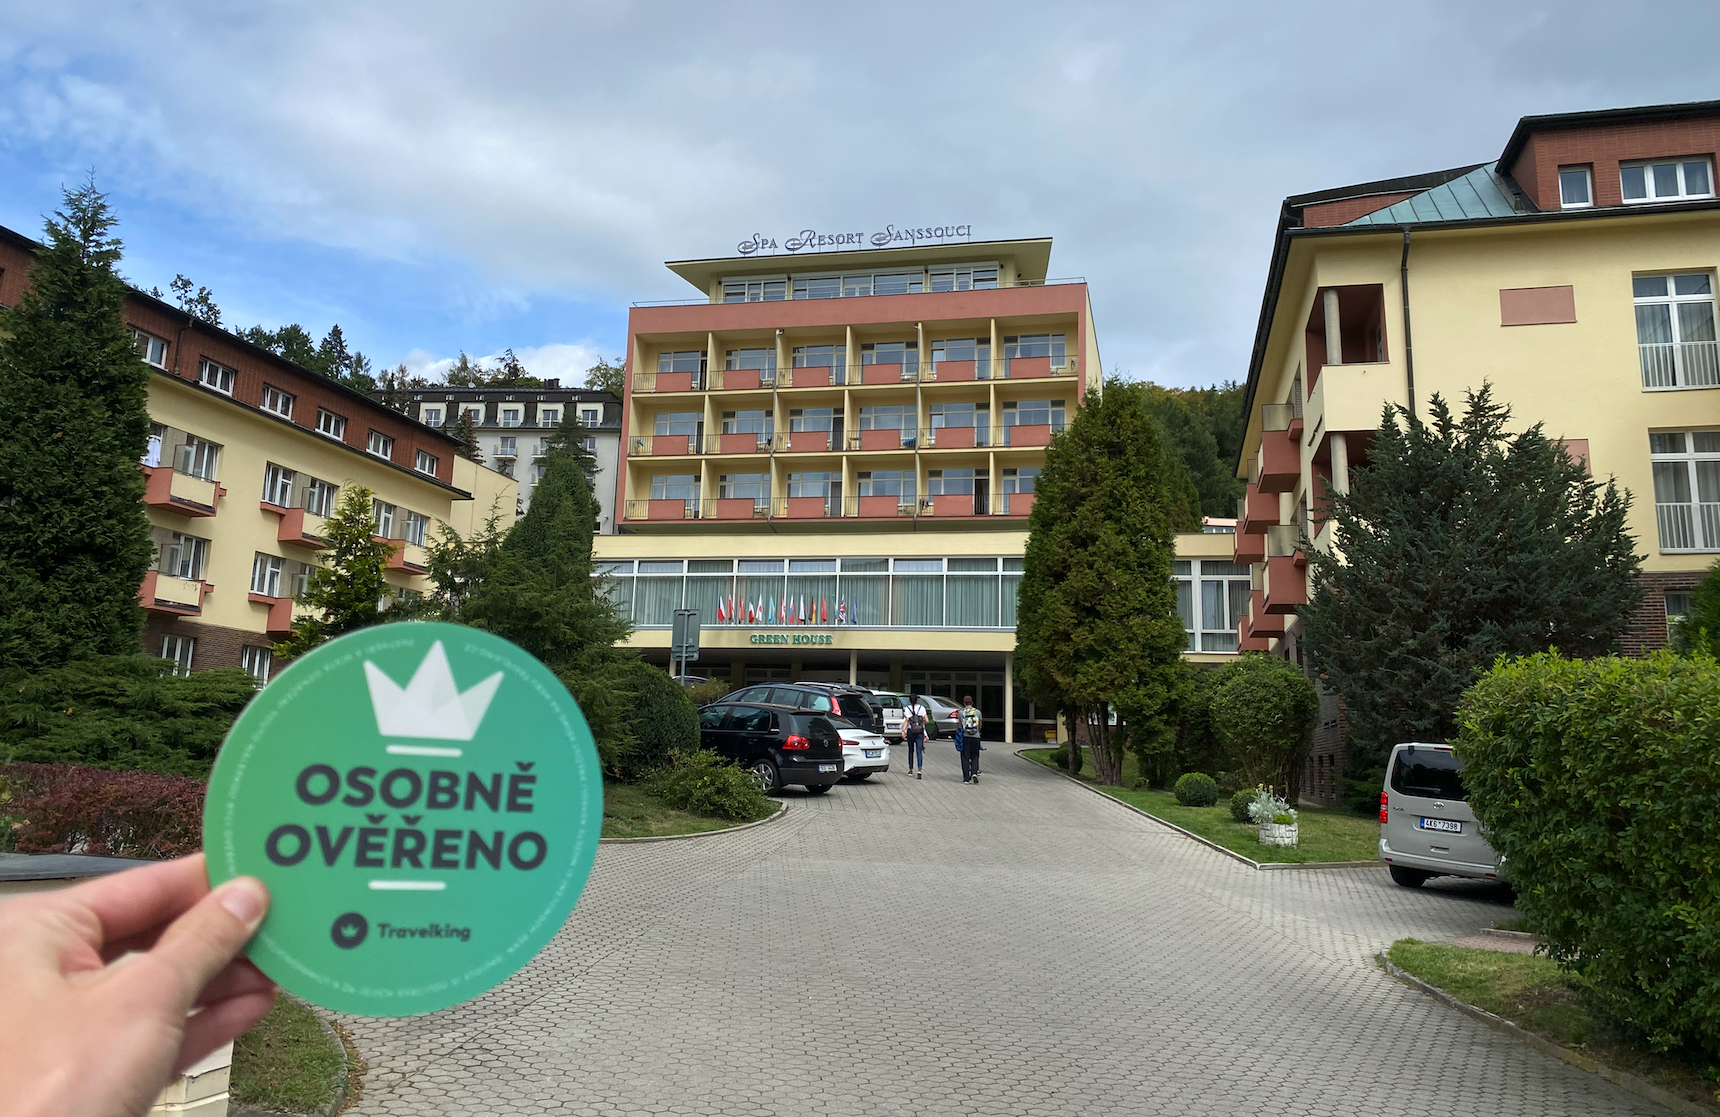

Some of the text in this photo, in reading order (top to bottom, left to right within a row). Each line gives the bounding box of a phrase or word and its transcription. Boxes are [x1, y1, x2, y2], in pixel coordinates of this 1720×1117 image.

[737, 224, 972, 254] SPA RESORT SANSSOUCI
[750, 634, 833, 645] GREEN HOUSE
[295, 761, 537, 813] OSOBNĚ
[264, 812, 548, 871] OVĚŘENO
[377, 922, 471, 942] Travelking
